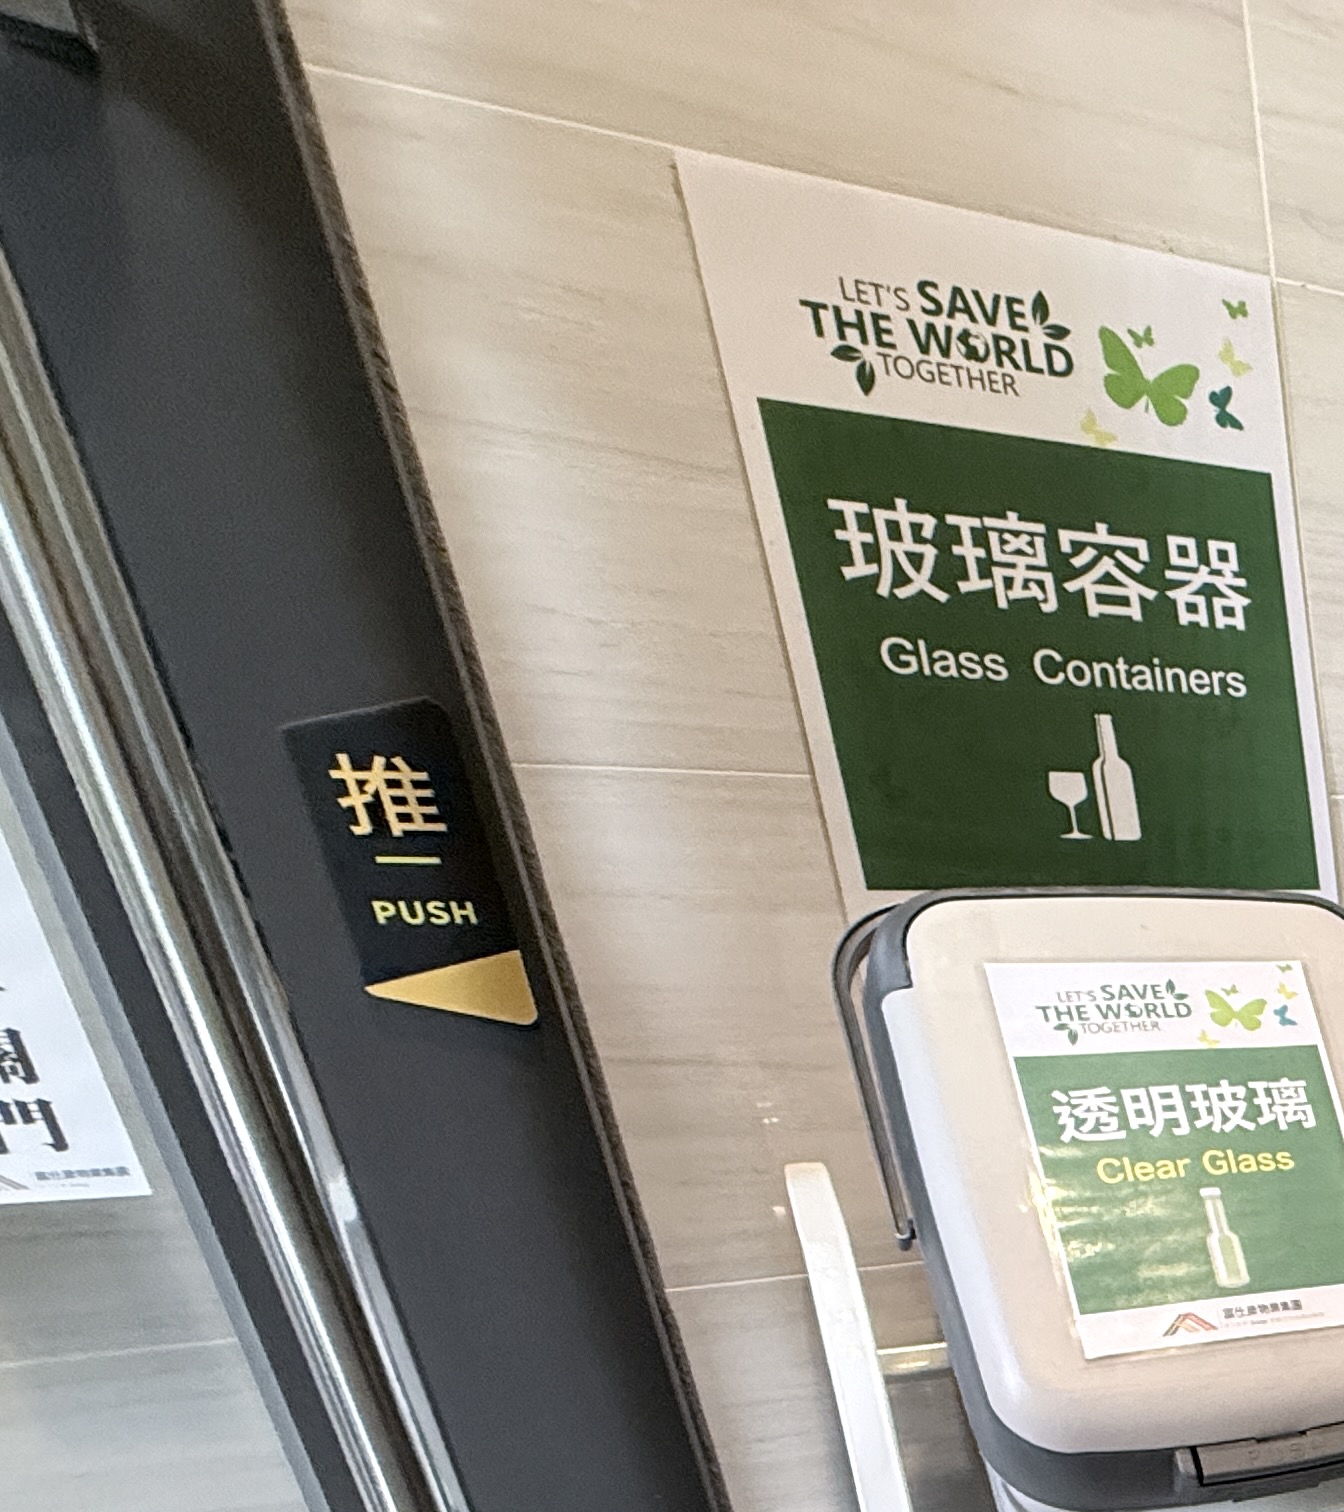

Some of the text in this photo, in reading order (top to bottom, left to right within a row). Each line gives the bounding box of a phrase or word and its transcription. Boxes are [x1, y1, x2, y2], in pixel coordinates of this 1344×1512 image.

[838, 276, 1030, 333] LET'S SAVE
[799, 299, 1075, 379] THE WORLD
[877, 353, 1020, 398] TOGETHER
[826, 497, 1253, 632] 玻璃容器
[879, 636, 1248, 698] Glass Containers
[328, 752, 448, 838] 推
[370, 899, 480, 926] PUSH
[1035, 1002, 1193, 1023] THE WORLD
[1099, 983, 1164, 1001] SAVE
[1080, 1020, 1161, 1034] TOGETHER
[1050, 1076, 1318, 1144] 透明玻璃
[1095, 1147, 1296, 1185] Clear Glass
